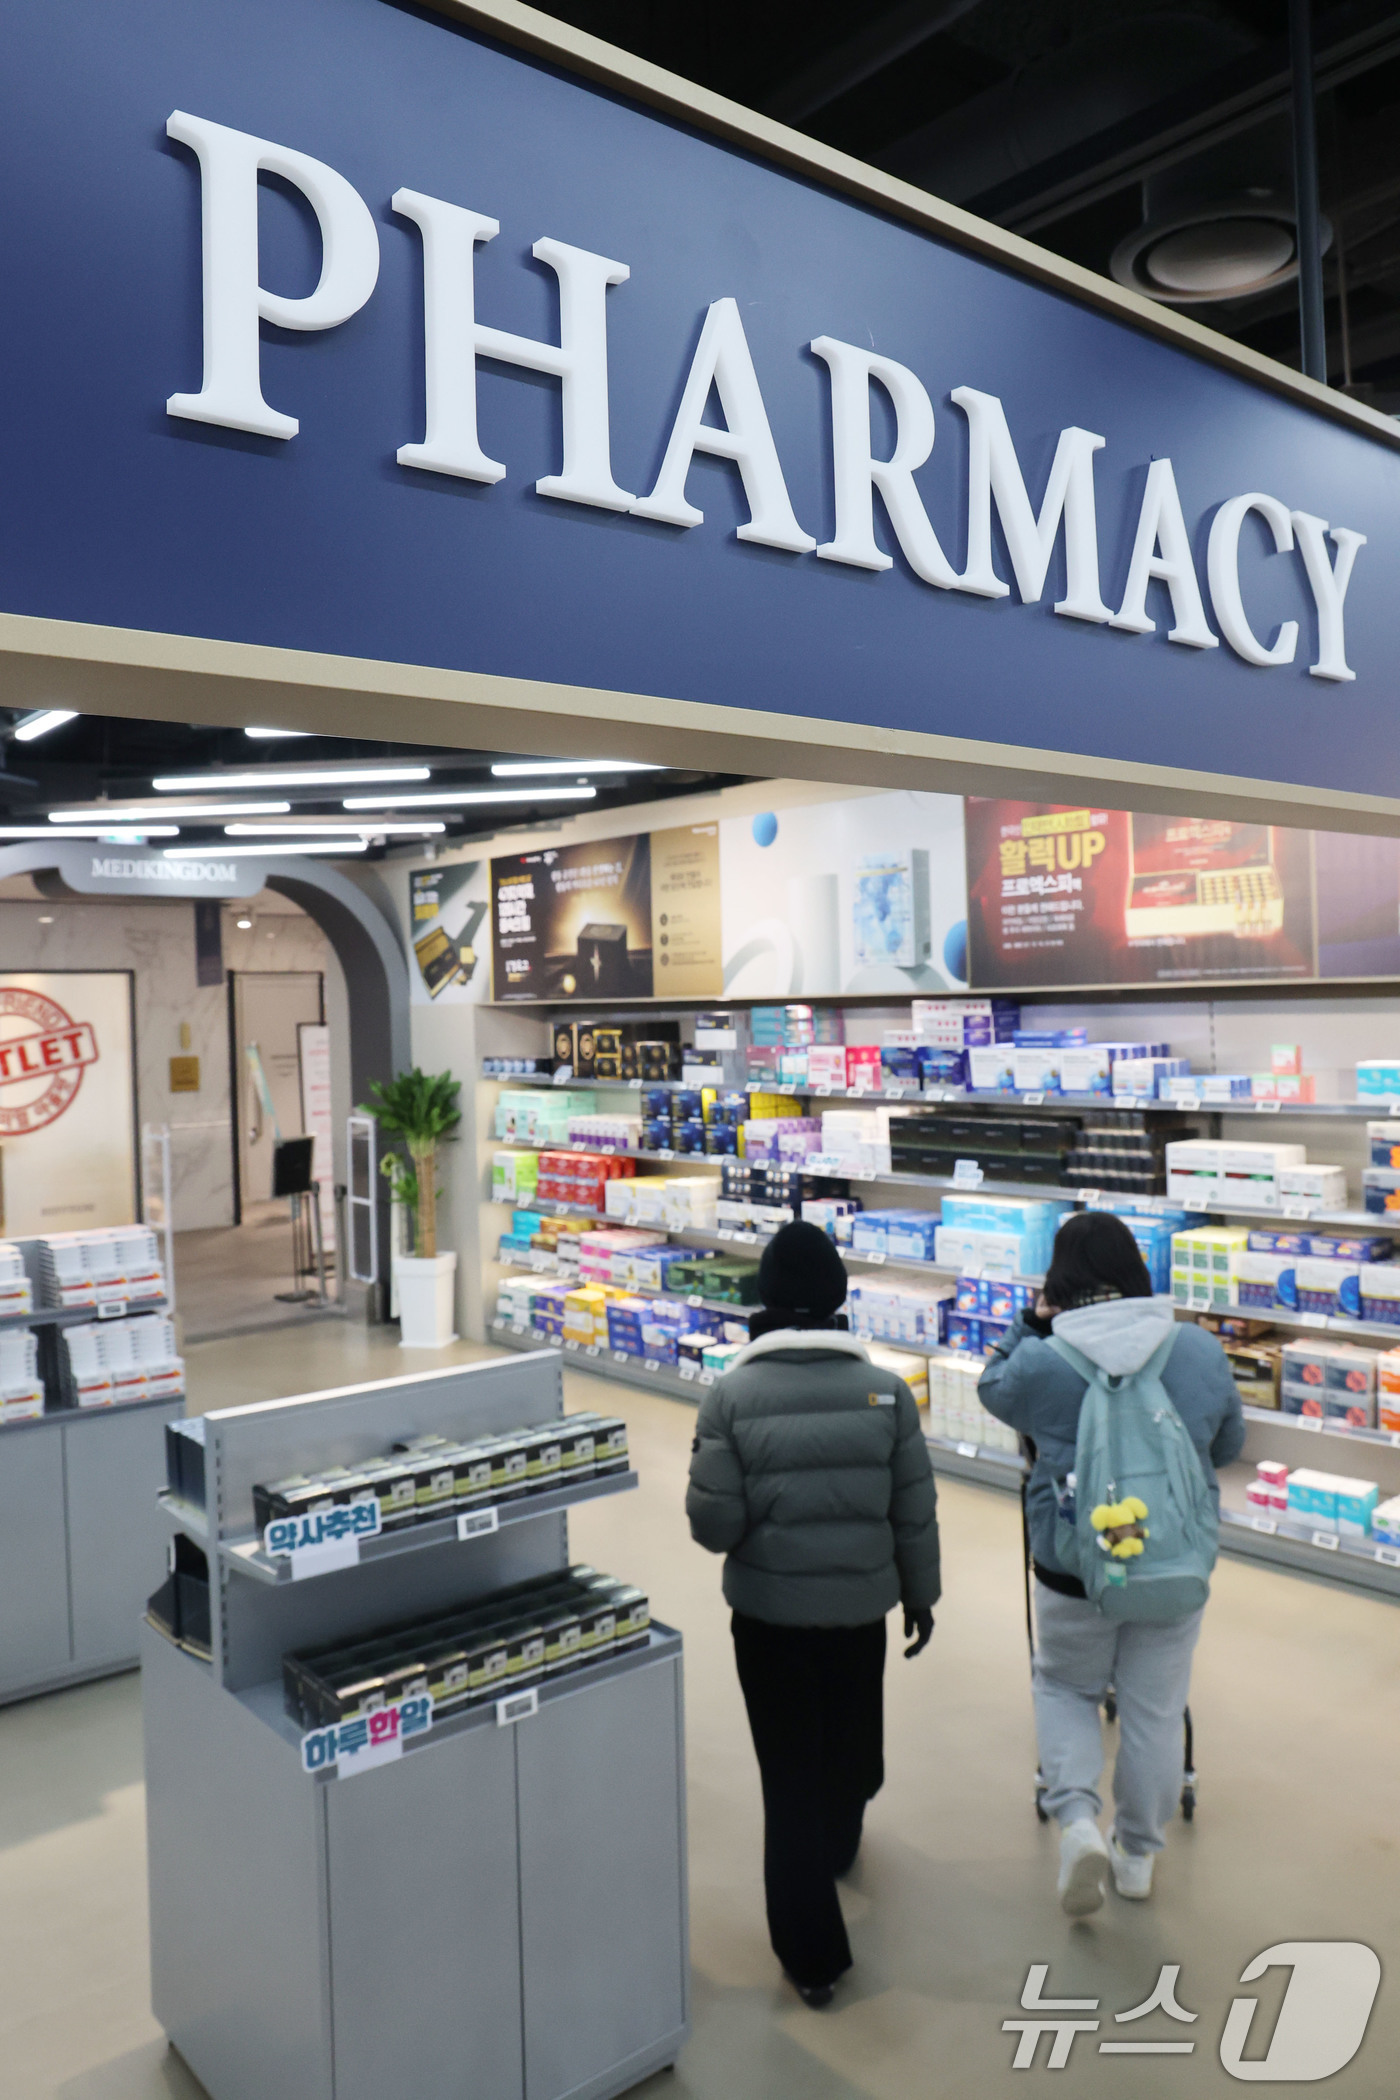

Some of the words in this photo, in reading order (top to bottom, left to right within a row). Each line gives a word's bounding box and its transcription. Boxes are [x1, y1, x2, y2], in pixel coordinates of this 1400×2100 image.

[166, 109, 1368, 683] PHARMACY
[91, 858, 237, 882] MEDIKINGDOM
[1000, 831, 1105, 876] 활력UP
[270, 1501, 377, 1551] 약사추천
[305, 1697, 430, 1769] 하루한알
